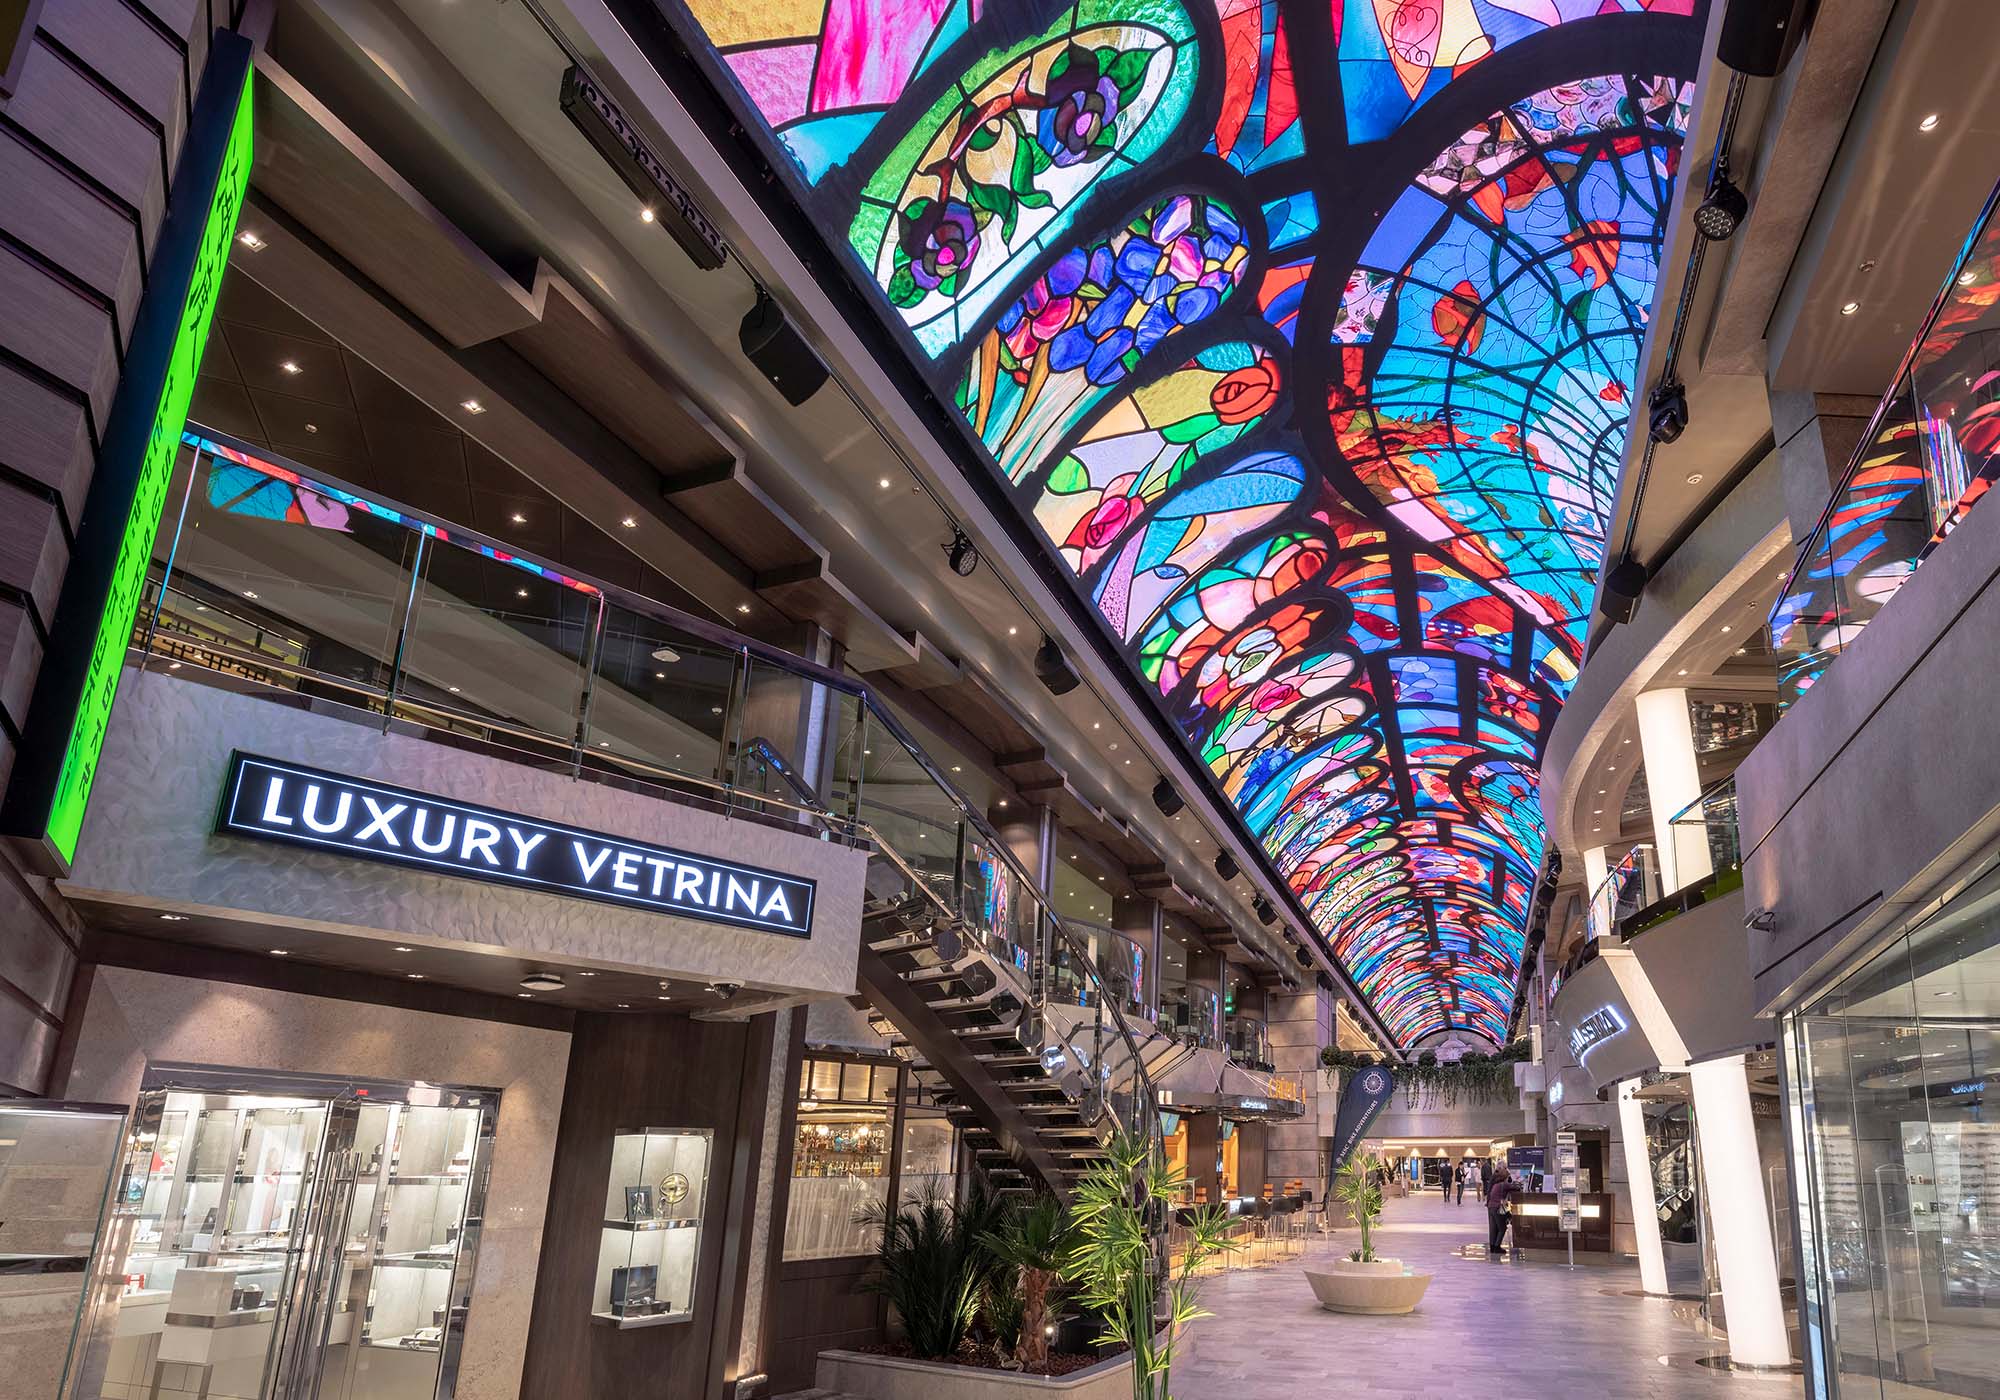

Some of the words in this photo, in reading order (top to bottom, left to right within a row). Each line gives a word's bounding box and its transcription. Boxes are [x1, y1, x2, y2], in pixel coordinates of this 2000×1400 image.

[78, 671, 114, 801] BAR
[261, 776, 546, 871] LUXURY
[573, 841, 794, 923] VETRINA
